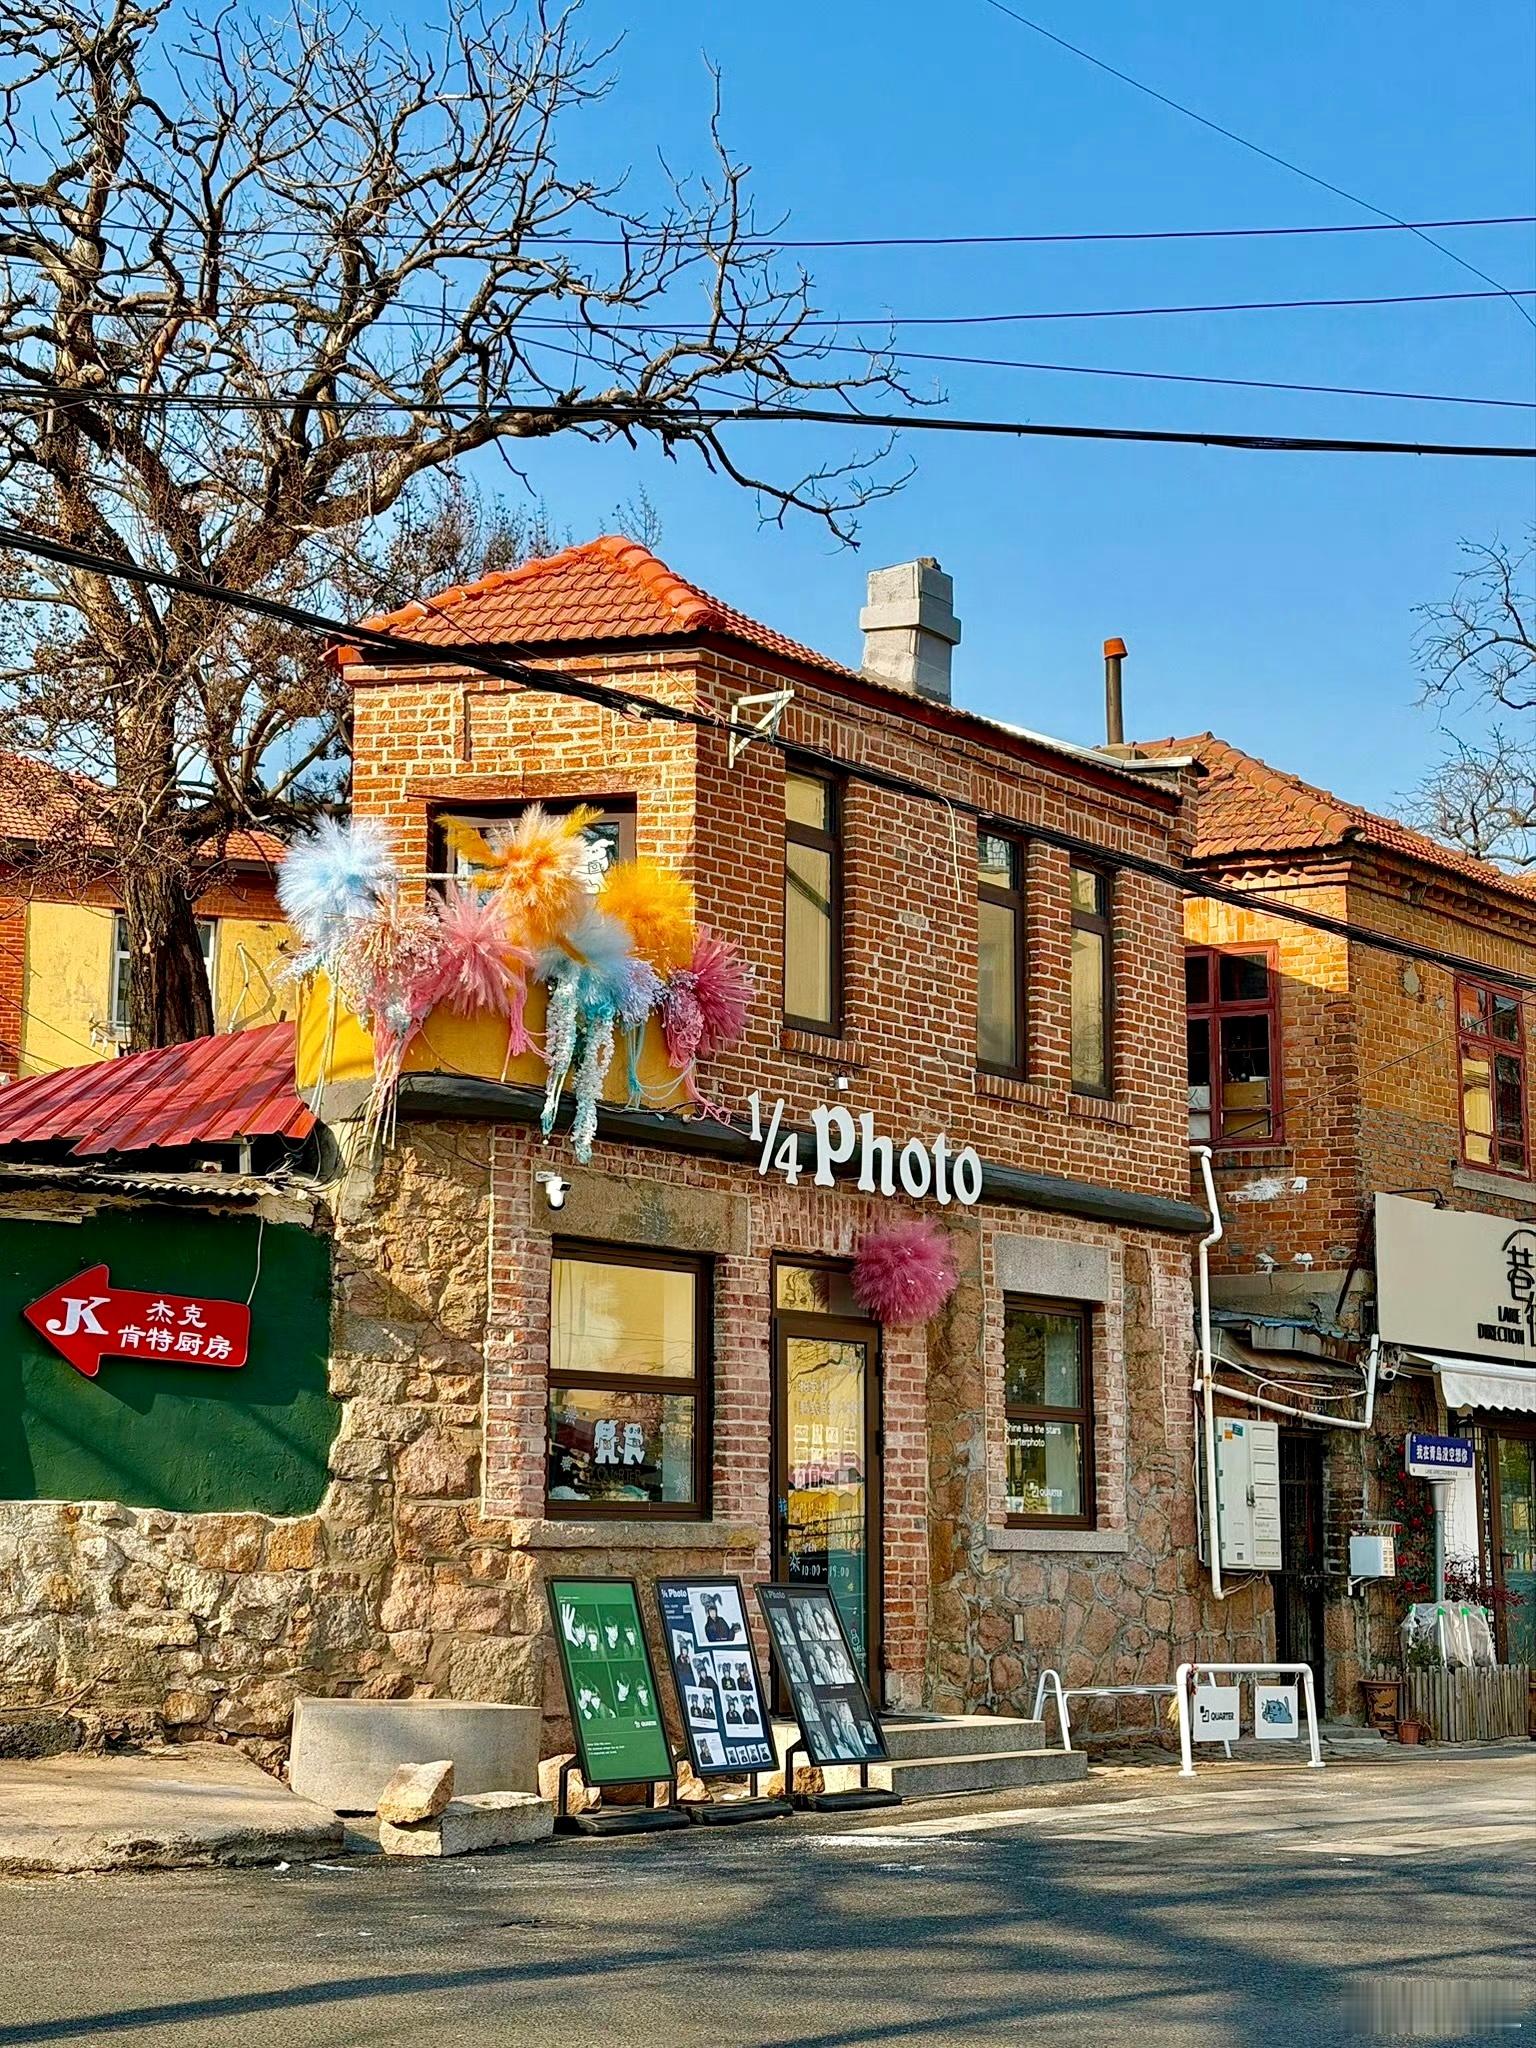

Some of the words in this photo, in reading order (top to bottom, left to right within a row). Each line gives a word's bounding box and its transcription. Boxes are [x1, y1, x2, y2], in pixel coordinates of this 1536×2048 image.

[811, 1104, 983, 1206] Photo
[46, 1296, 111, 1336] JK
[146, 1300, 207, 1328] 杰克
[117, 1324, 233, 1359] 肯特厨房
[1477, 1323, 1524, 1344] DIRECTION
[1211, 1711, 1234, 1720] QUARTER
